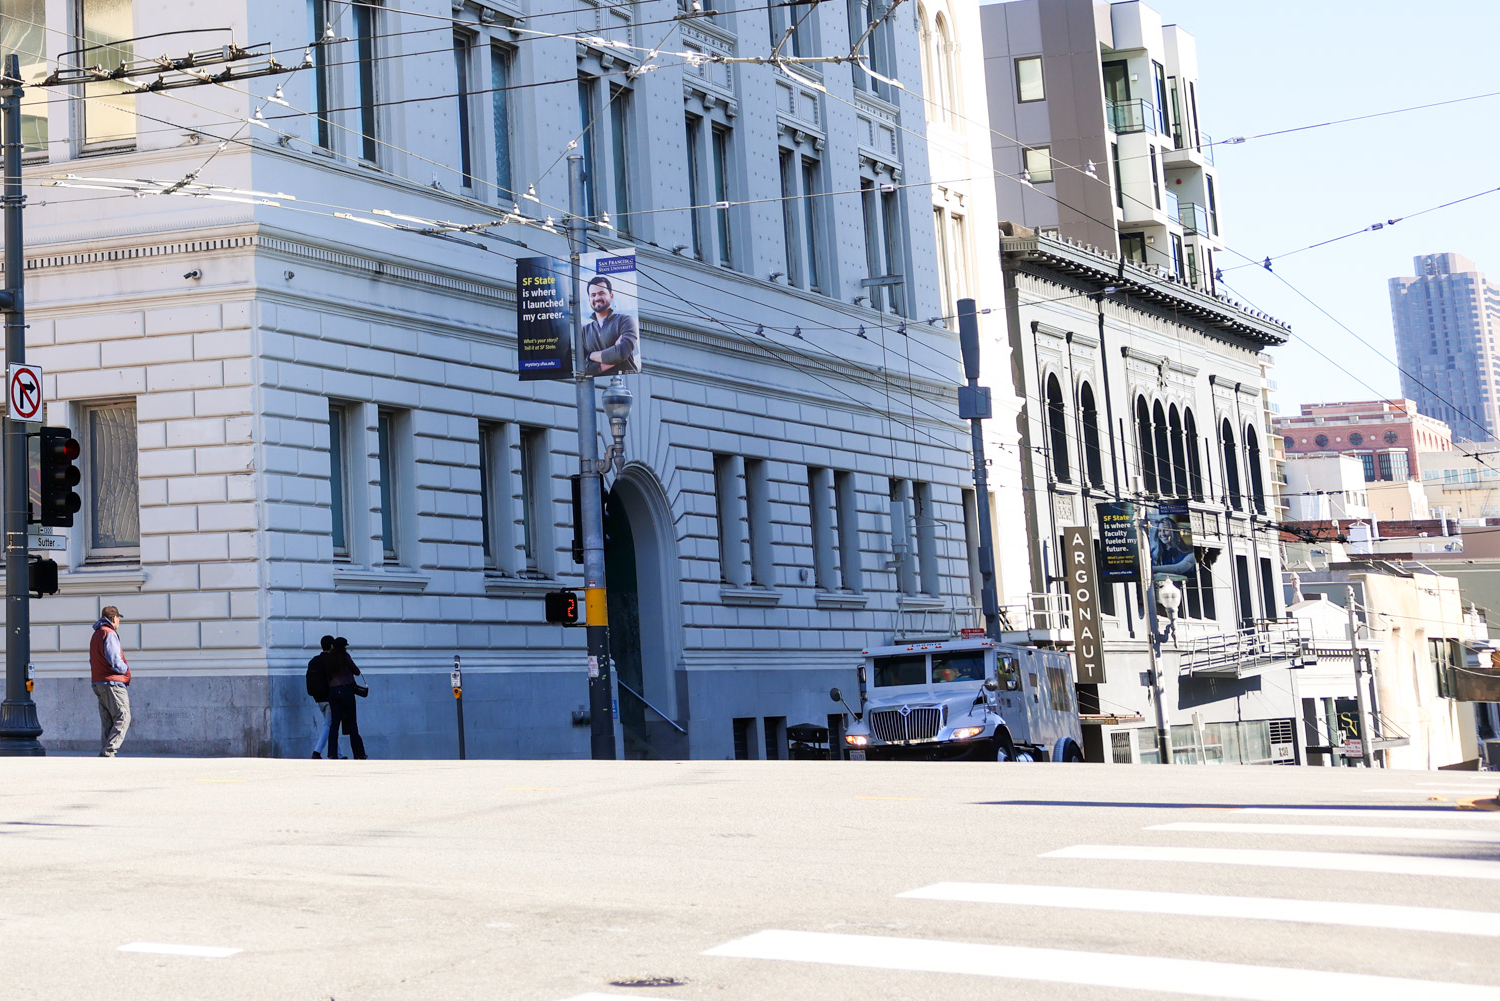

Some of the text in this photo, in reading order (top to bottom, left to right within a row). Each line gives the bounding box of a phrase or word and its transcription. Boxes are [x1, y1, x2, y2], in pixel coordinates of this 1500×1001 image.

[522, 276, 556, 286] SF State
[522, 287, 556, 297] is where
[522, 298, 564, 309] I launched
[523, 312, 565, 322] my career.
[38, 537, 55, 547] Sutter
[567, 598, 575, 618] 2
[1072, 532, 1096, 678] ARGONAUT
